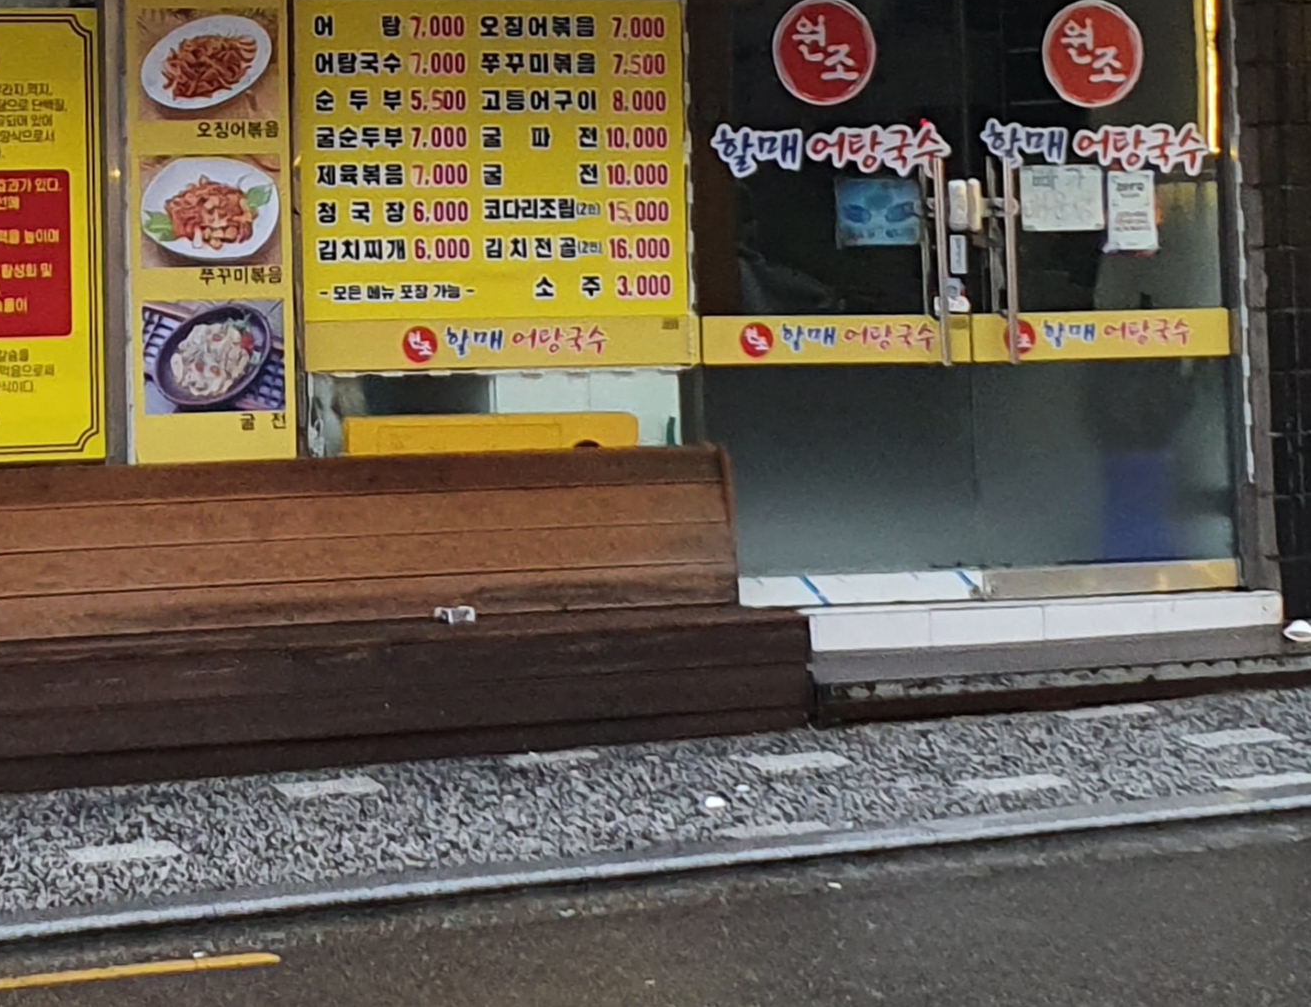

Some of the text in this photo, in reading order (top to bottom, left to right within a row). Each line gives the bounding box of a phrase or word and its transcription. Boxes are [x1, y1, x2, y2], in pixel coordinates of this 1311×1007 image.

[792, 14, 859, 80] 원조
[1061, 17, 1126, 82] 원조
[197, 120, 279, 138] 오징어볶음
[712, 122, 950, 177] 할매 어탕국수
[1073, 123, 1208, 174] 어탕국수
[447, 326, 503, 357] 할매
[511, 325, 608, 354] 어탕국수
[844, 323, 935, 351] 어탕국수
[1103, 318, 1190, 345] 어탕국수
